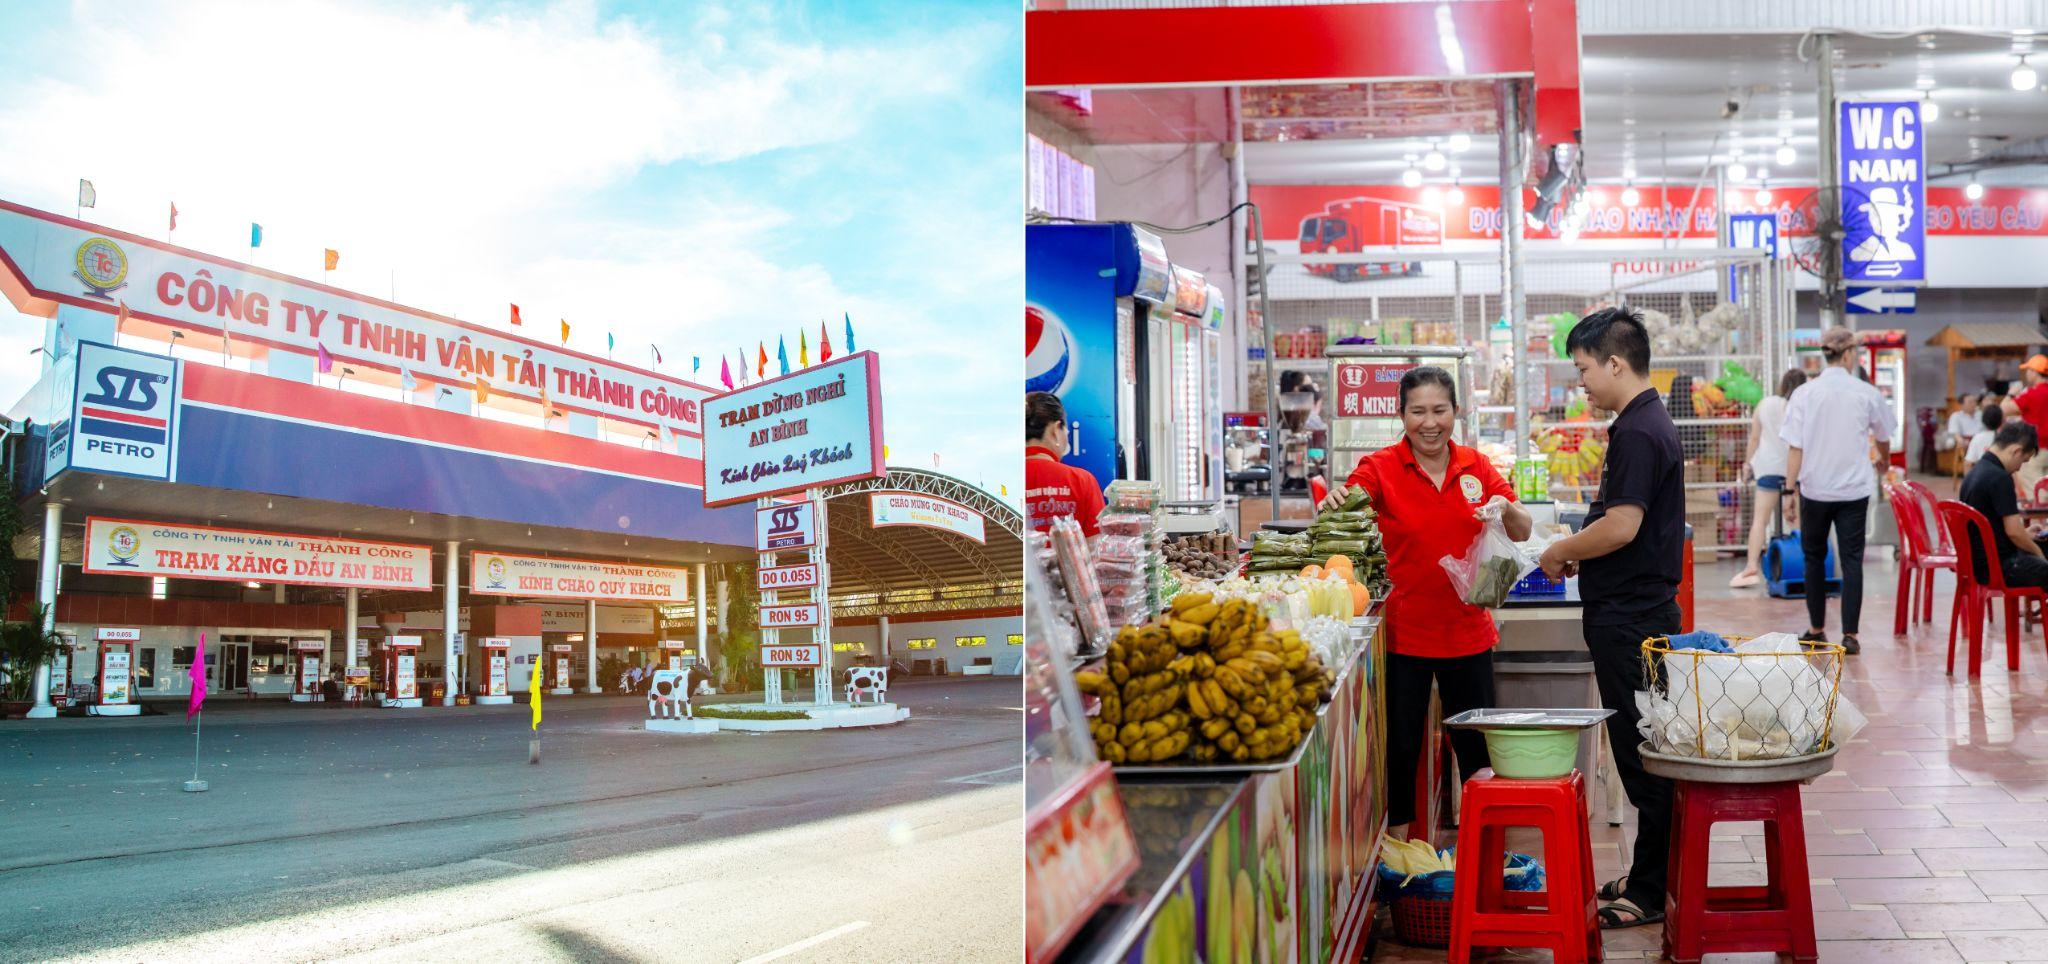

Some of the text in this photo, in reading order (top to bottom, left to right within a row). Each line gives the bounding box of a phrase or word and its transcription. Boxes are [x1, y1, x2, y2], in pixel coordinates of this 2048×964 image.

[1849, 106, 1915, 150] W.C
[1849, 158, 1917, 183] NAM
[1628, 202, 1690, 237] NHẬN
[1955, 203, 1997, 230] YÊU
[157, 269, 697, 424] CÔNG TY TNHH VẬN TẢI THÀNH CÔNG
[719, 403, 760, 428] TRẠM
[762, 391, 804, 417] DỪNG
[1363, 397, 1396, 414] MINH
[749, 418, 808, 447] AN BÌNH
[49, 439, 67, 461] PETRO
[87, 439, 155, 459] PETRO
[750, 460, 780, 482] Chào
[809, 442, 853, 467] Khách
[153, 529, 189, 540] CÔNG
[213, 535, 245, 544] TNHH
[297, 541, 361, 556] THÀNH
[368, 546, 413, 559] CÔNG
[776, 539, 795, 547] PETRO
[155, 550, 220, 573] TRẠM
[226, 551, 288, 576] XĂNG
[340, 563, 367, 579] AN
[372, 561, 413, 582] BÌNH
[513, 559, 536, 567] CÔNG
[549, 562, 570, 570] TNHH
[602, 566, 643, 576] THÀNH
[647, 568, 676, 579] CÔNG
[763, 569, 812, 585] DO 0.05S
[518, 572, 671, 596] KÍNH CHÀO QUÝ KHÁCH
[769, 609, 809, 623] RON 95
[771, 649, 810, 662] RON 92
